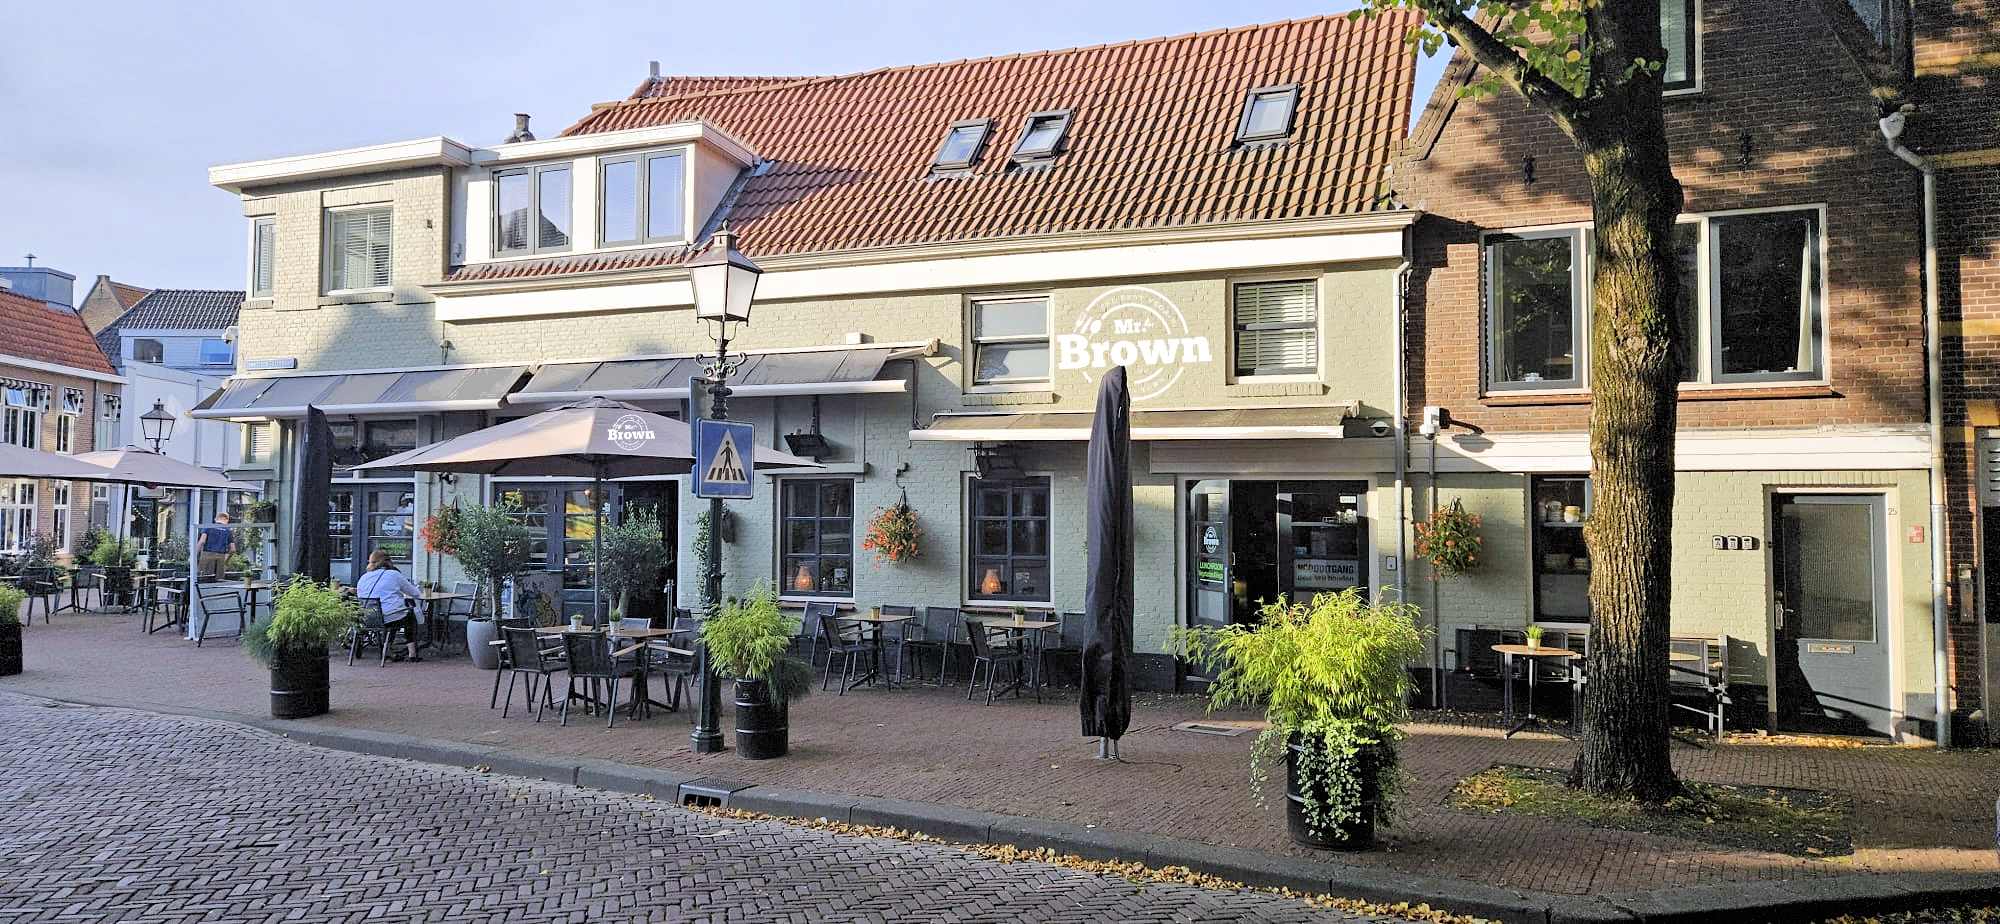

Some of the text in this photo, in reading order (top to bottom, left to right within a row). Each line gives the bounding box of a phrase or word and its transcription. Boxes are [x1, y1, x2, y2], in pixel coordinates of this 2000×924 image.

[1120, 294, 1144, 302] BEST
[1113, 319, 1147, 335] Mr.
[1056, 334, 1213, 370] Brown
[1140, 376, 1165, 393] TOWN
[607, 429, 656, 441] Brown
[1887, 507, 1898, 516] 25
